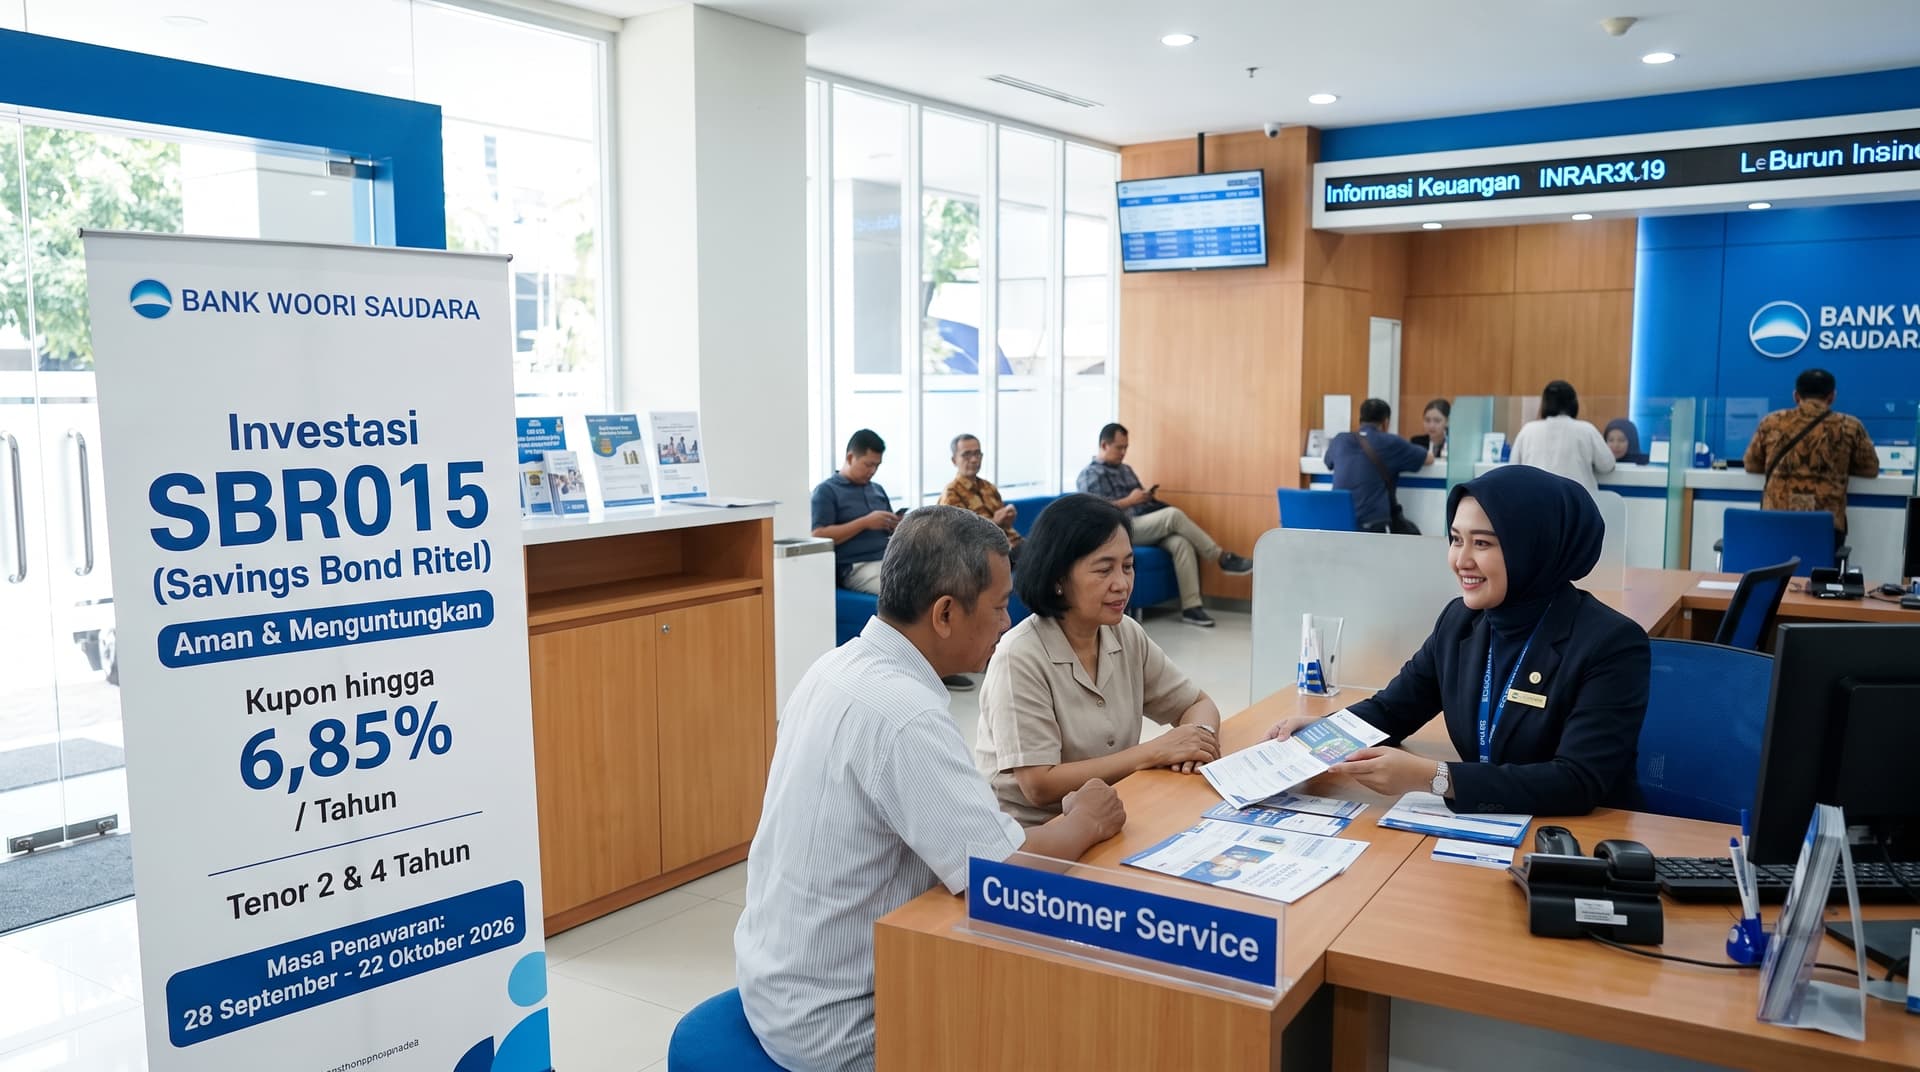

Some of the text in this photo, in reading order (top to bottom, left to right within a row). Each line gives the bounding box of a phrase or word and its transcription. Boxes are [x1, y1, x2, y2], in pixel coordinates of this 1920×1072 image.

[1326, 178, 1413, 203] Informasi
[1418, 174, 1521, 197] Keuangan
[181, 288, 481, 321] BANK WOORI SAUDARA
[1820, 305, 1895, 327] BANK
[1819, 329, 1920, 350] SAUDAR
[229, 409, 419, 451] Investasi
[148, 460, 489, 552] SBR015
[153, 539, 492, 605] (Savings Bond Ritel)
[174, 601, 482, 657] Aman & Menguntungkan
[245, 665, 435, 716] Kupon hingga
[239, 700, 453, 795] 6,85%
[295, 788, 397, 832] / Tahun
[226, 840, 471, 921] Tenor 2 & 4 Tahun
[267, 914, 446, 979] Masa Penawaran:
[982, 875, 1259, 962] Customer Service
[183, 1005, 213, 1031] 28
[219, 970, 338, 1020] September
[358, 955, 384, 979] 22
[389, 933, 465, 969] Oktober
[469, 916, 515, 944] 2026
